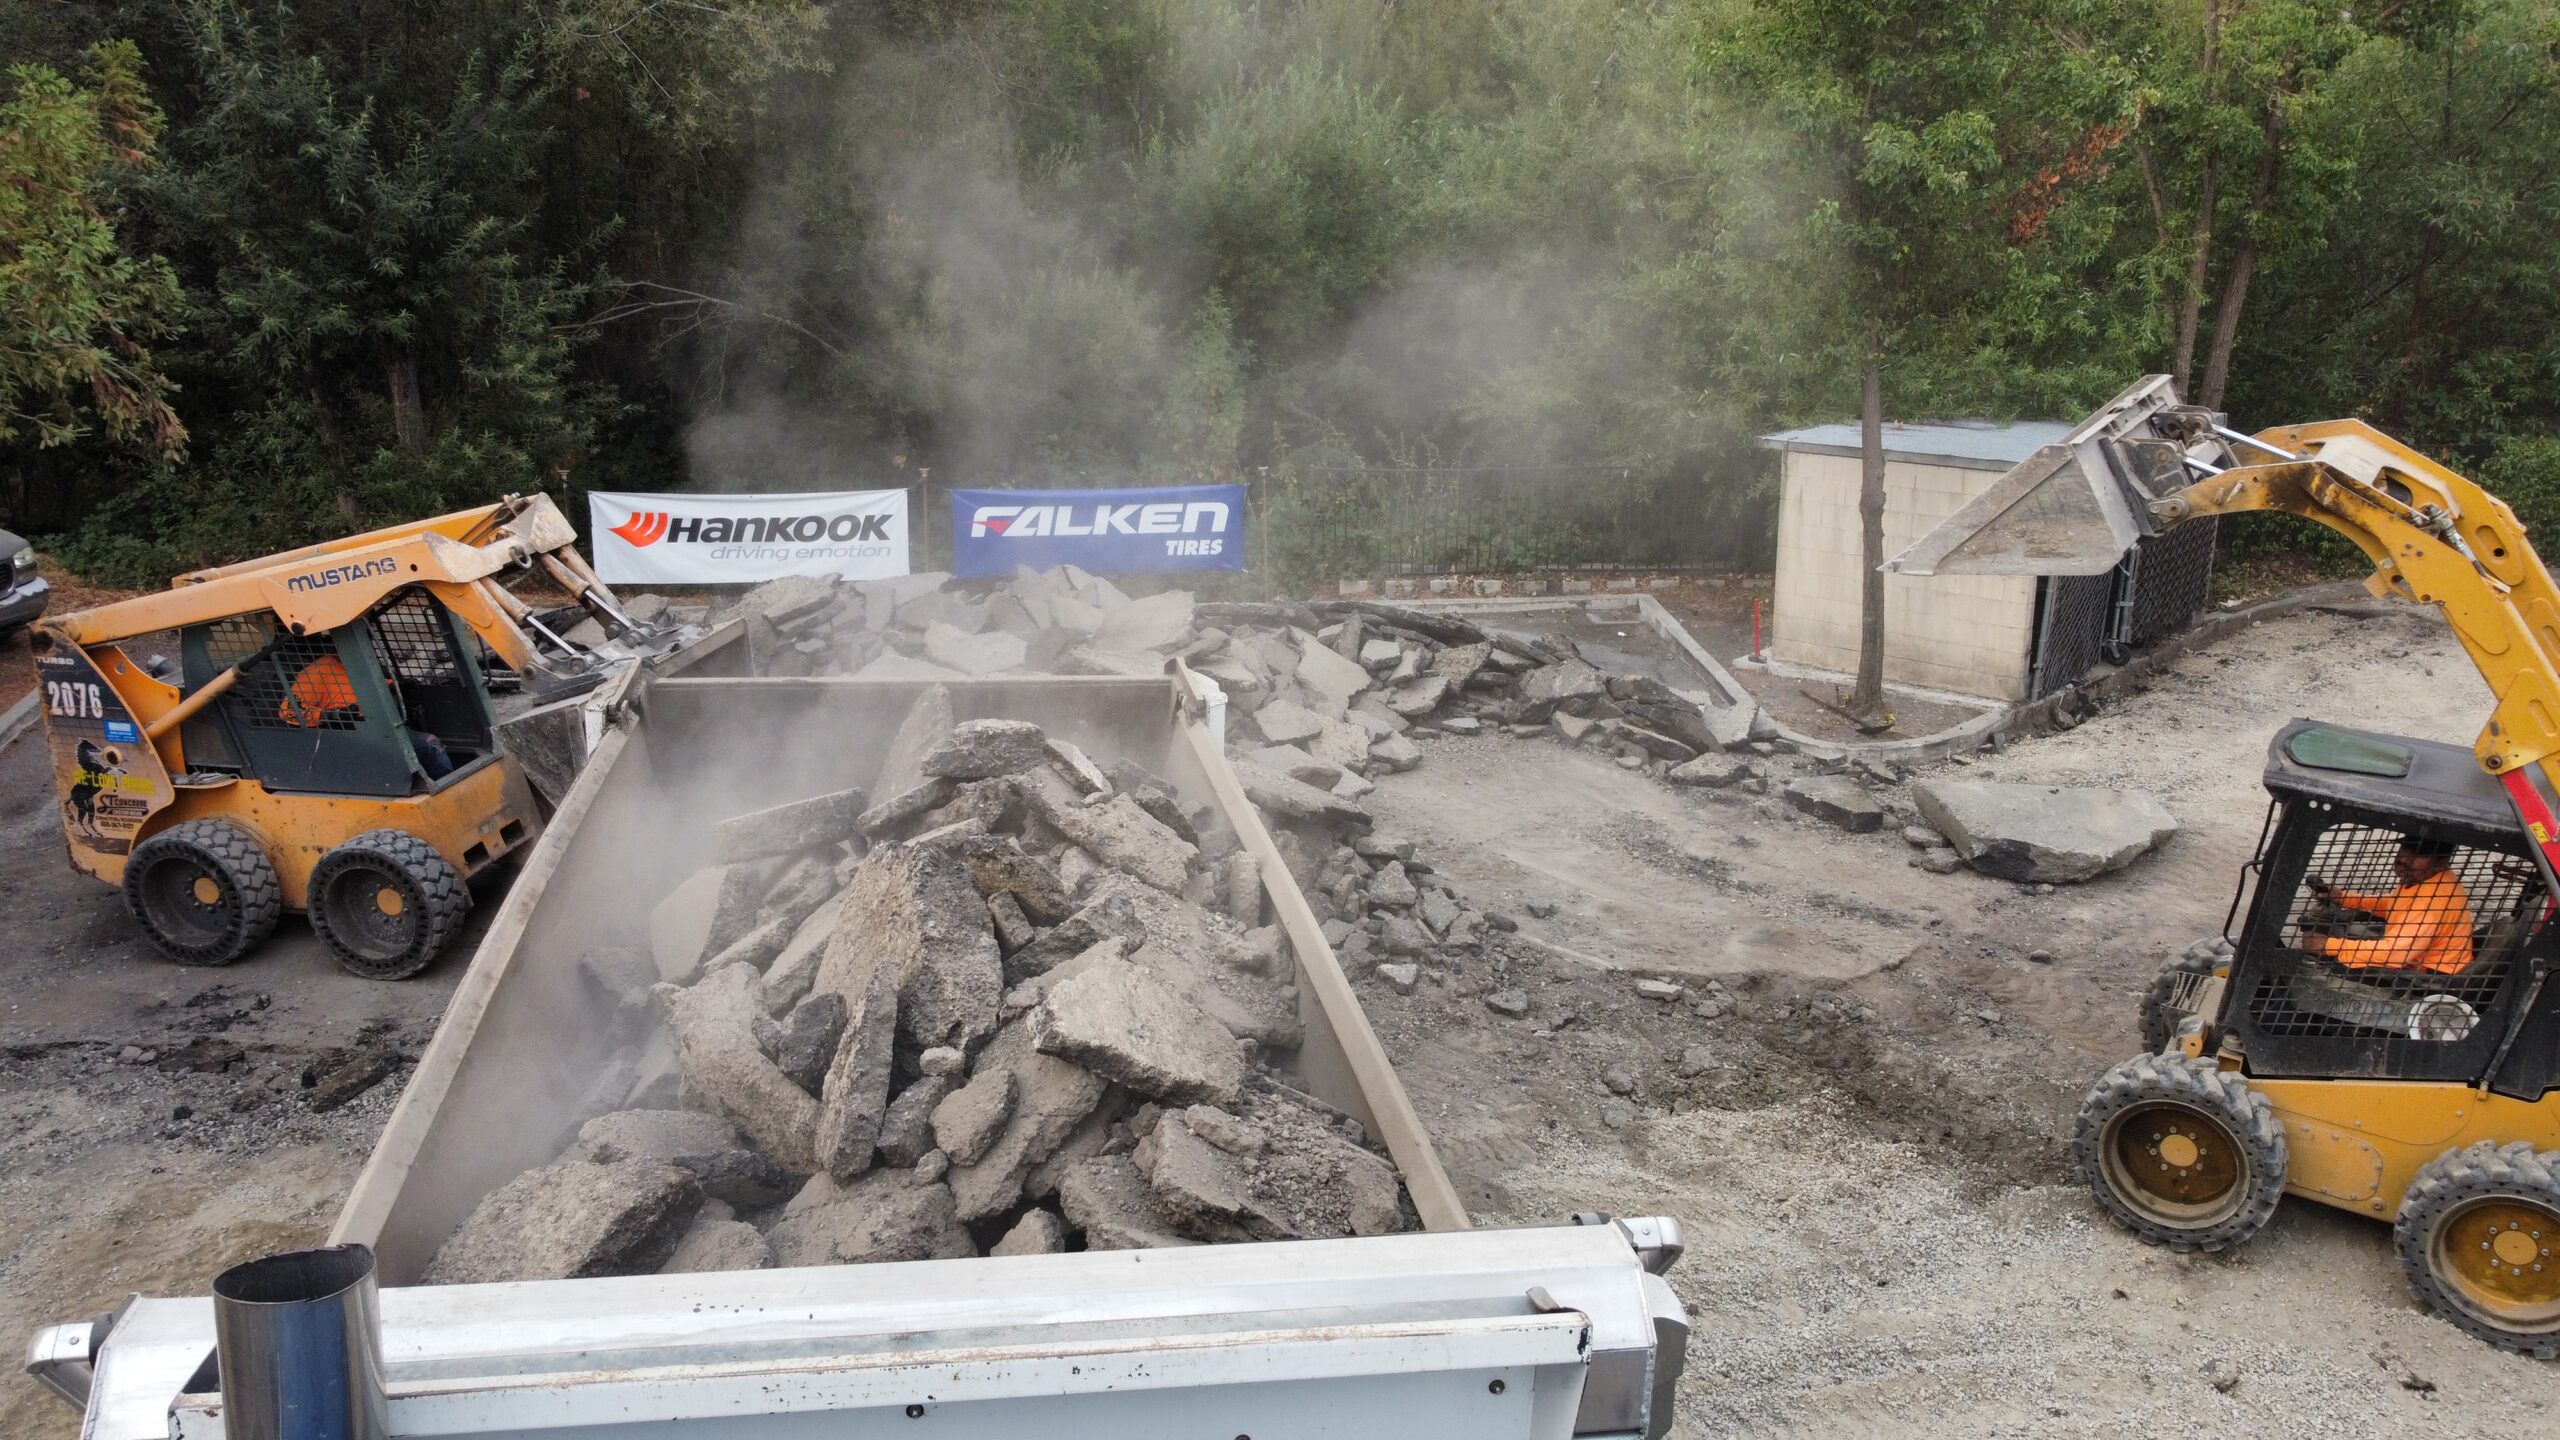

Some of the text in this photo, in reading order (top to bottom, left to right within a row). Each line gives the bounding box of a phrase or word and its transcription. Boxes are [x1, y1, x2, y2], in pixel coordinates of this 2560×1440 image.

[969, 502, 1230, 538] FALKEN
[710, 545, 892, 562] driving emotion
[1166, 539, 1223, 556] TIRES
[287, 557, 397, 593] MUSTANG
[35, 656, 74, 665] TURBO
[47, 681, 103, 719] 2076
